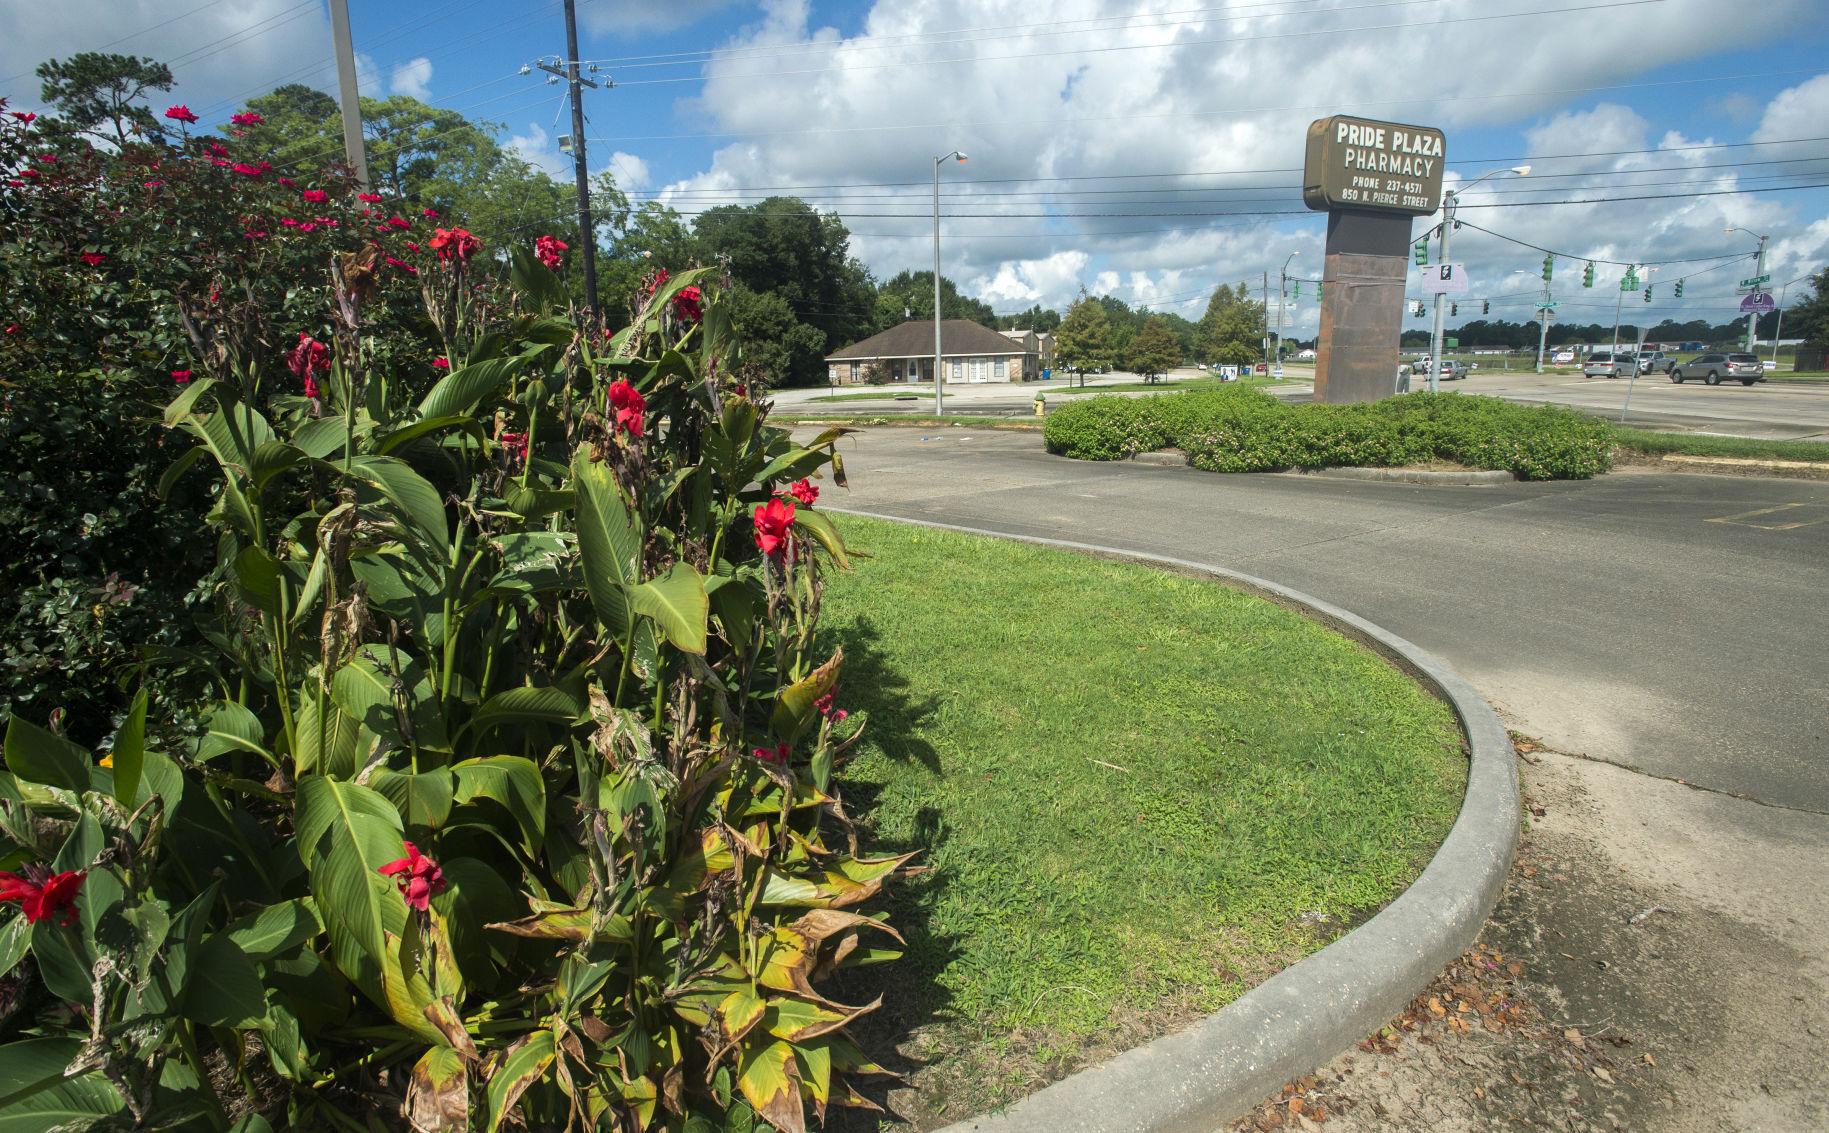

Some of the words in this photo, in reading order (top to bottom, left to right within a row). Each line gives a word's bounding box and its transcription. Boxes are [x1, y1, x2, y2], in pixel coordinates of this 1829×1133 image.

[1337, 122, 1385, 149] PRIDE
[1393, 131, 1442, 157] PLAZA
[1345, 148, 1434, 178] PHARMACY
[1352, 176, 1379, 189] PHONE
[1387, 181, 1422, 194] 237-4571
[1342, 189, 1358, 201] 850
[1373, 192, 1398, 205] PIERCE
[1402, 196, 1429, 208] STREET
